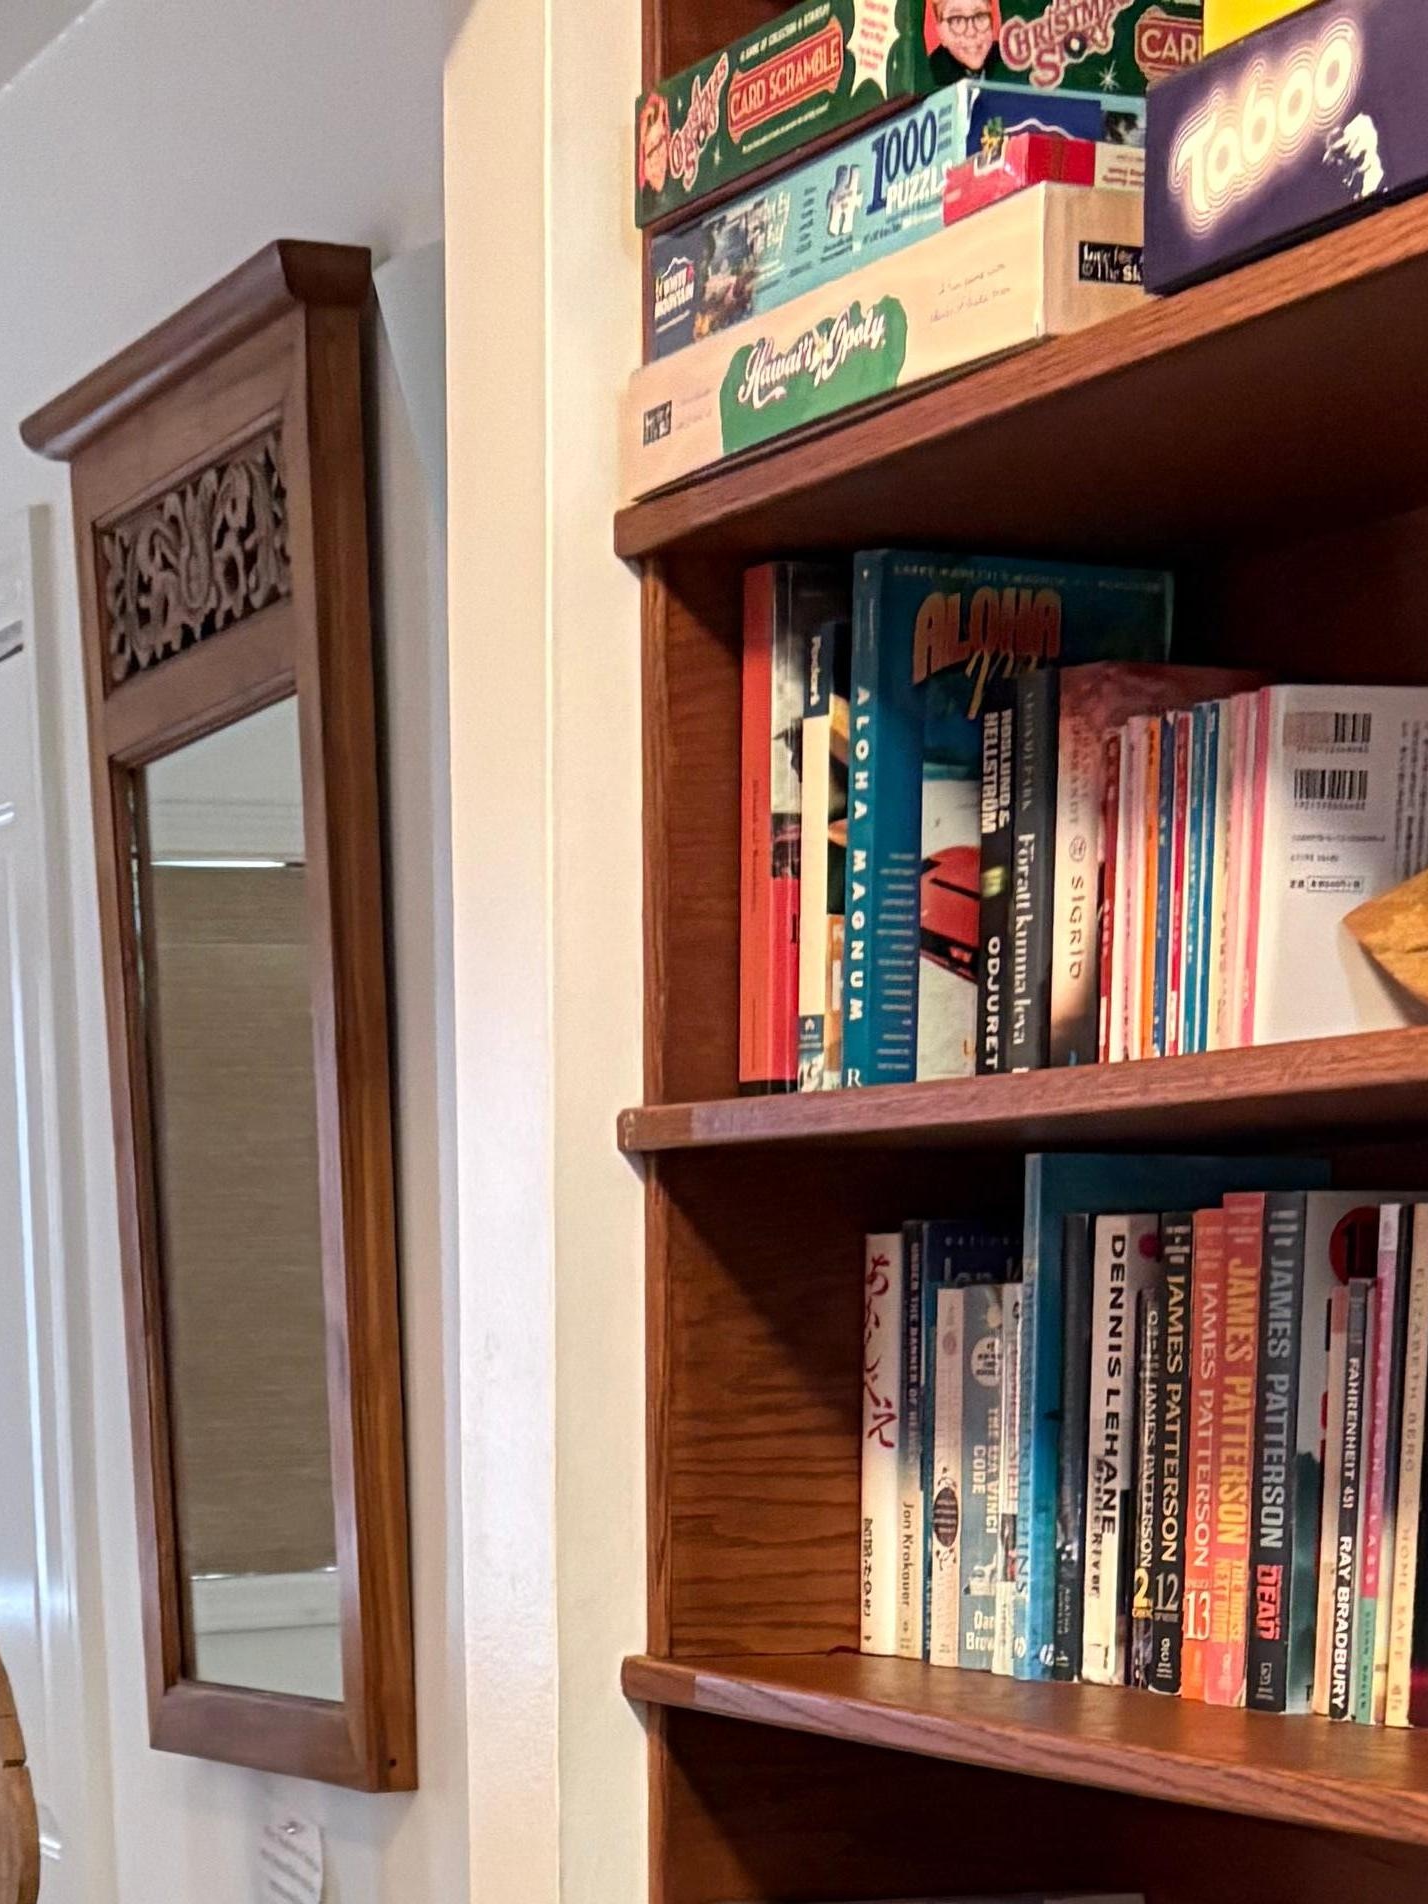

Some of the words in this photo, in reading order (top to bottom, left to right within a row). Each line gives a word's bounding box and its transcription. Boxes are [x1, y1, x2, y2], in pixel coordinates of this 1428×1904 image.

[730, 80, 766, 123] CARD
[768, 37, 840, 97] SCRAMBLE
[1175, 38, 1353, 213] Taboo
[867, 110, 938, 214] 1000
[852, 685, 870, 820] ALOHA
[850, 849, 868, 1021] MAGNUM
[1068, 876, 1085, 980] SIGRID
[985, 936, 1001, 1071] ODJURET
[1108, 1234, 1126, 1379] DENNIS
[1167, 1274, 1185, 1375] JAMES
[1200, 1282, 1218, 1380] JAMES
[1225, 1257, 1258, 1363] JAMES
[1267, 1255, 1294, 1360] JAMES
[971, 1444, 987, 1495] CODE
[1101, 1387, 1121, 1538] LEHANE
[1218, 1376, 1252, 1547] PATTERSON
[1259, 1373, 1291, 1549] PATTERSON
[1342, 1357, 1361, 1481] FAHRENHEIT
[902, 1502, 915, 1525] Jon
[1161, 1383, 1183, 1563] PATTERSON
[1193, 1389, 1215, 1568] PATTERSON
[901, 1533, 915, 1608] Krakauer
[1155, 1572, 1179, 1612] 12
[1338, 1535, 1353, 1580] RAY
[1183, 1590, 1211, 1641] 13
[1331, 1585, 1351, 1710] BRADBURY
